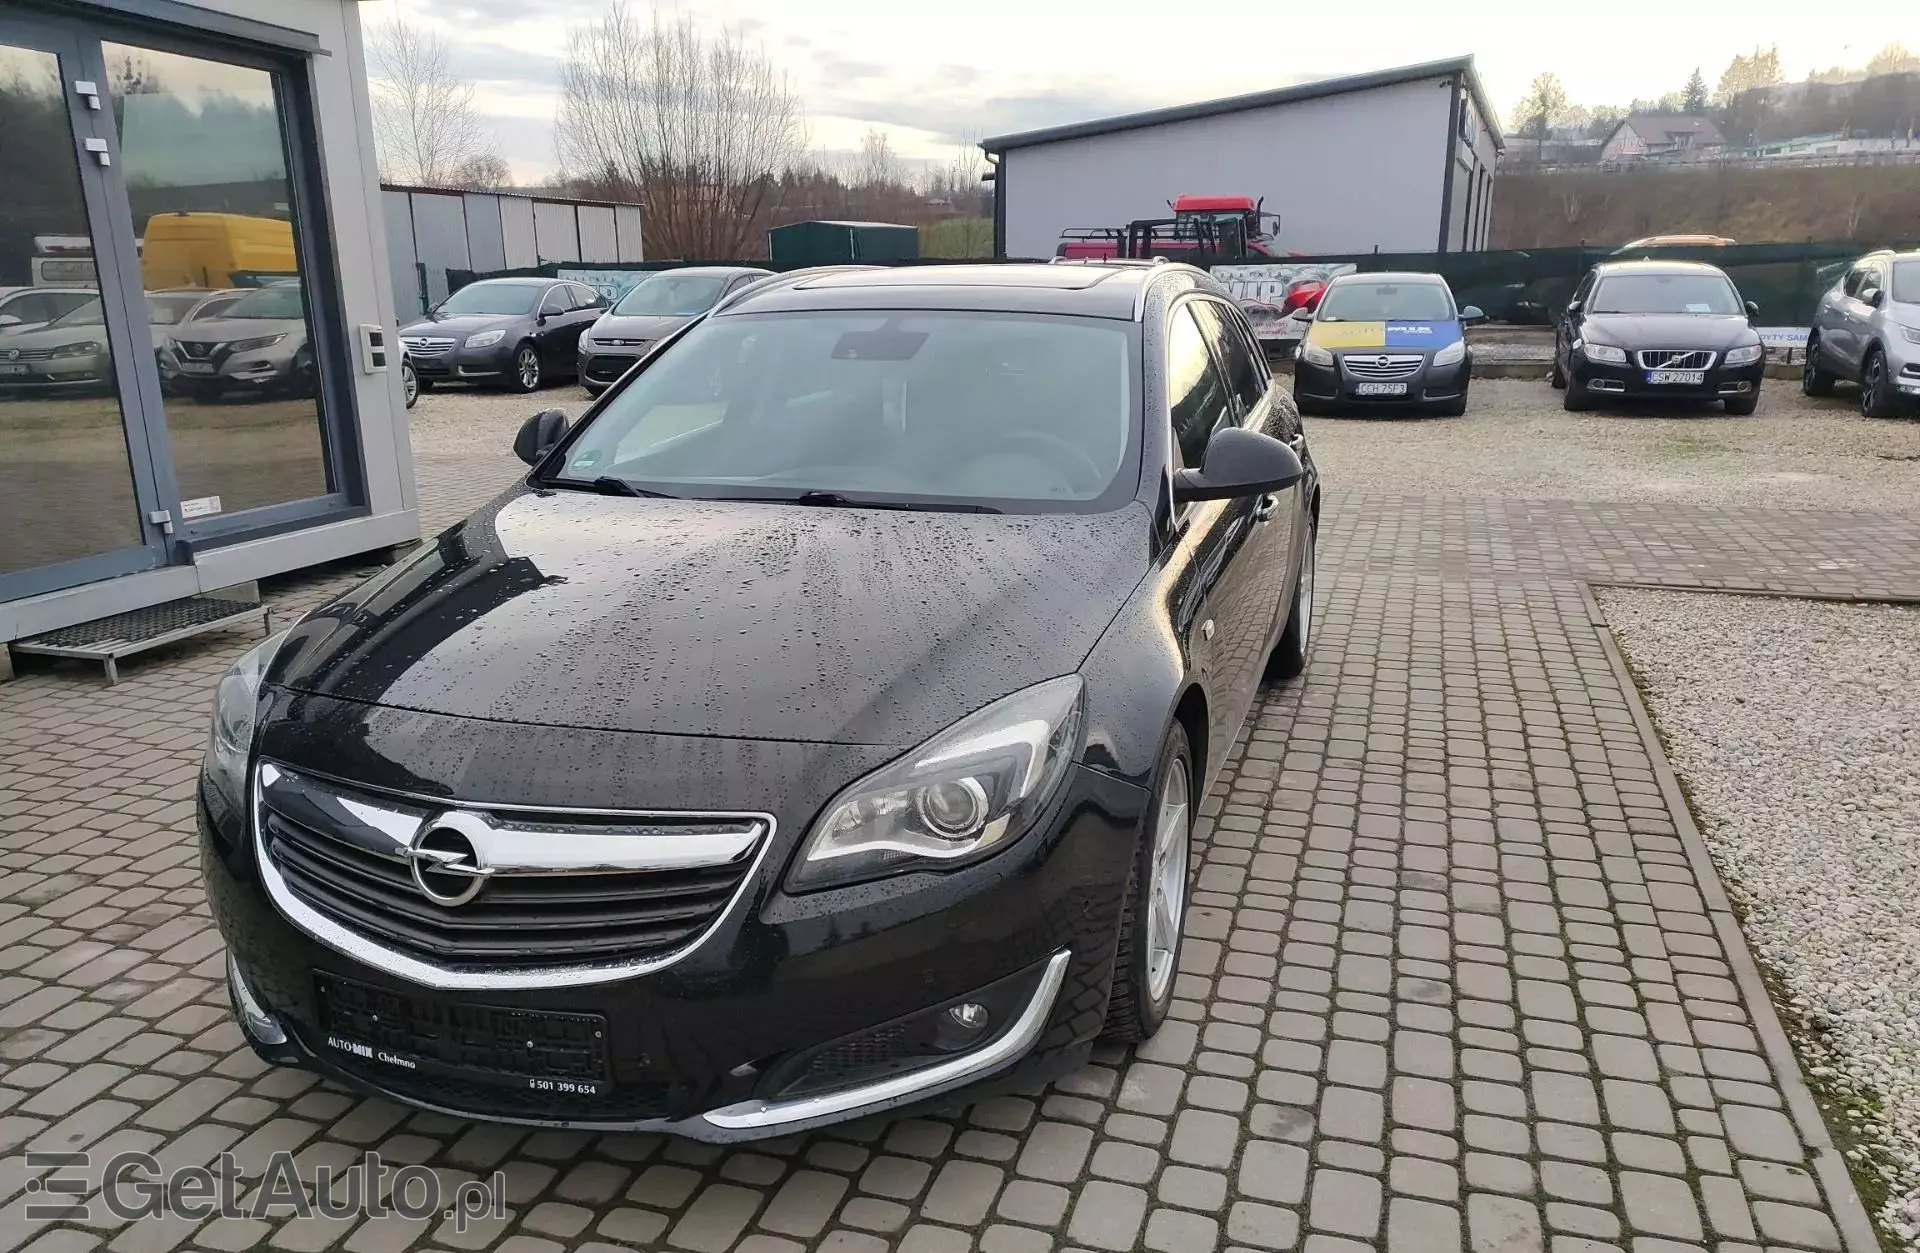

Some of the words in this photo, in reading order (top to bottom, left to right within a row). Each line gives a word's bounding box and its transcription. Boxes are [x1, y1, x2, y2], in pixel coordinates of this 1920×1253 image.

[536, 1080, 554, 1090] 501
[557, 1082, 575, 1093] 399
[577, 1084, 596, 1094] 654
